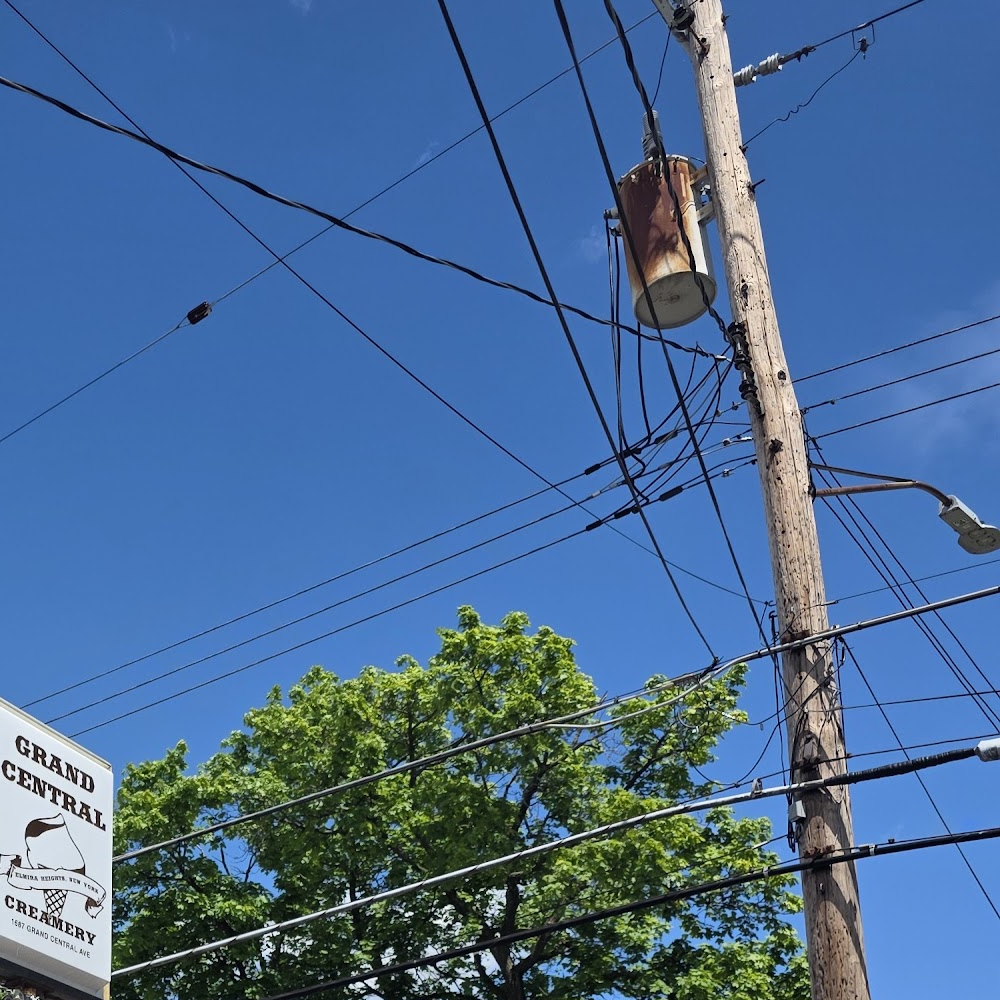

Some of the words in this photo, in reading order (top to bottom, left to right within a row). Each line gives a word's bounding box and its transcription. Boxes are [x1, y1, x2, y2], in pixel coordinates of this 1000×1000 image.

[15, 735, 95, 794] GRAND
[1, 759, 107, 832] CENTRAL
[15, 872, 38, 881] ELMIRA
[69, 877, 81, 885] NEW
[83, 882, 99, 894] YORK
[4, 894, 97, 946] CREAMERY
[11, 918, 25, 930] 1687
[26, 925, 49, 940] GRAND
[50, 935, 78, 953] CENTRAL
[79, 948, 91, 959] AVE
